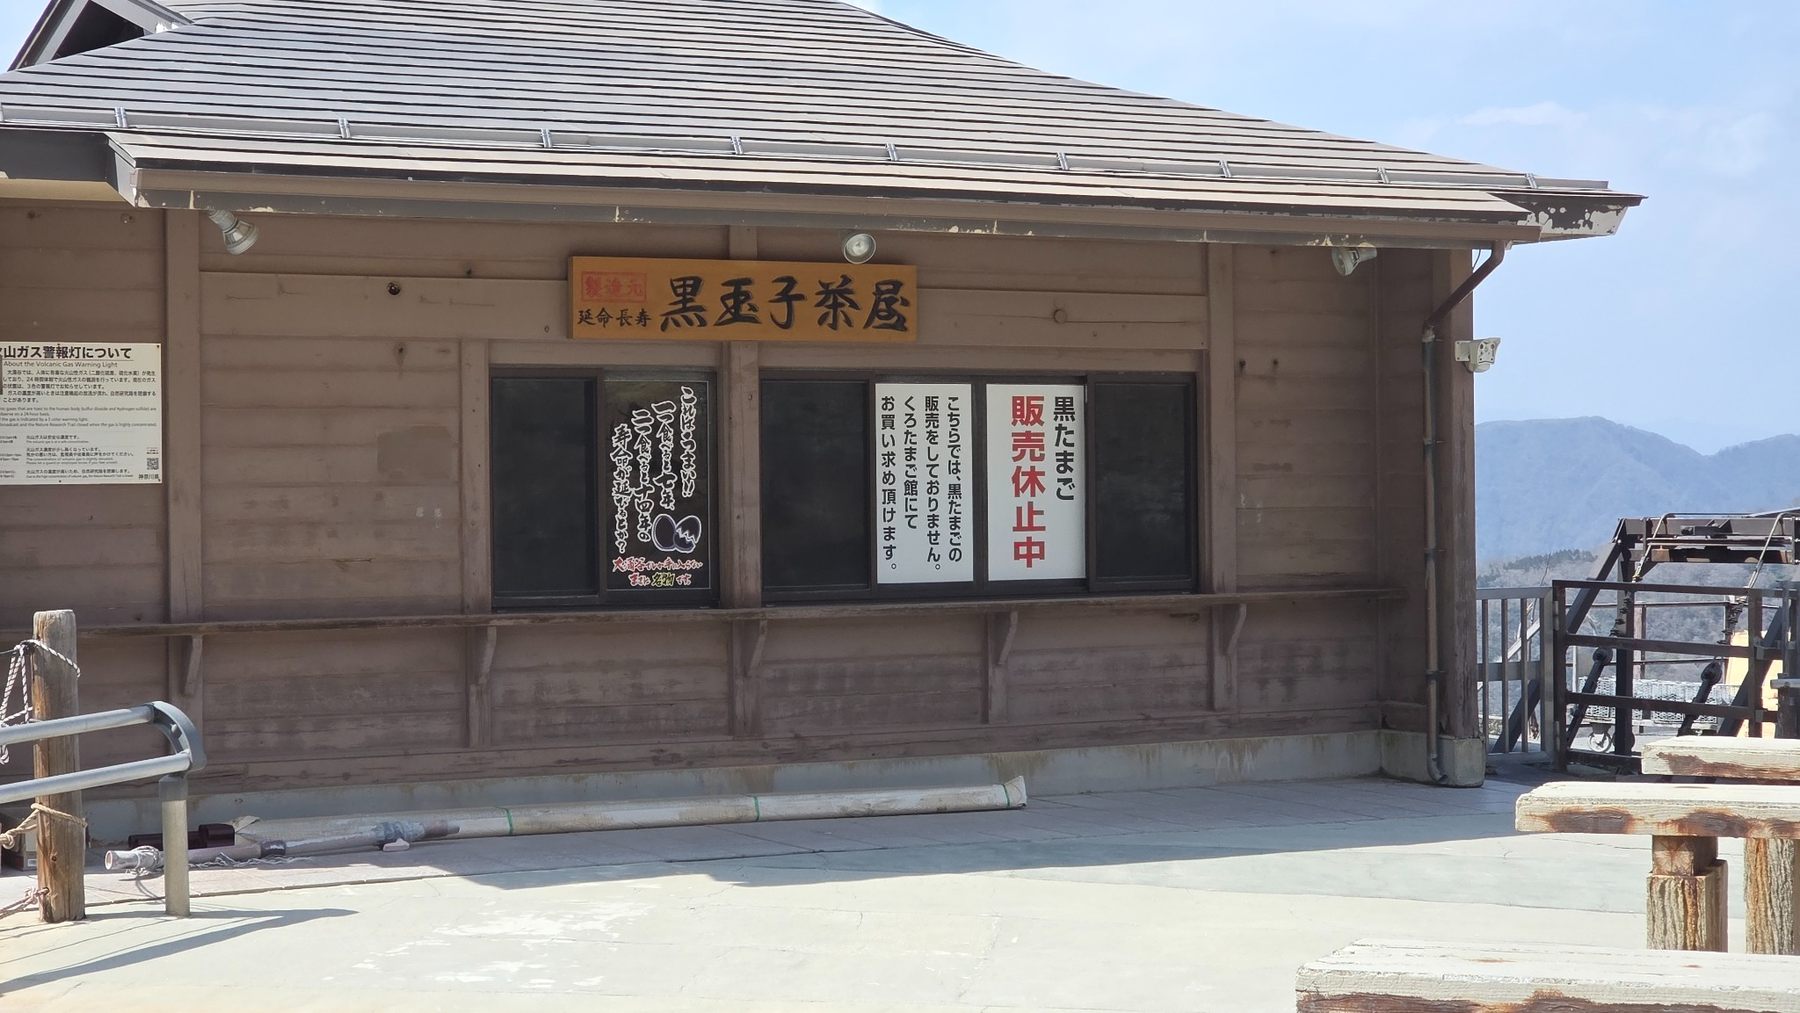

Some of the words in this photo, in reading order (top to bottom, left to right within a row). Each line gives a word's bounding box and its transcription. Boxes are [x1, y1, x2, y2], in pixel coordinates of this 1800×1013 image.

[0, 345, 132, 359] 山ガス警報灯について
[75, 361, 101, 369] Warning
[102, 361, 118, 369] Light
[577, 307, 652, 328] 延命長寿
[660, 274, 912, 332] 黒玉子茶屋
[631, 409, 655, 542] 二つ食べると十四年の
[881, 396, 897, 570] お買い求め頂けます。
[903, 396, 918, 529] くろたまご館にて
[925, 396, 941, 570] 販売をしておりません。
[947, 396, 963, 562] こちらでは、黒たまごの
[1011, 395, 1046, 568] 販売休止中
[1053, 396, 1076, 501] 黒たまご
